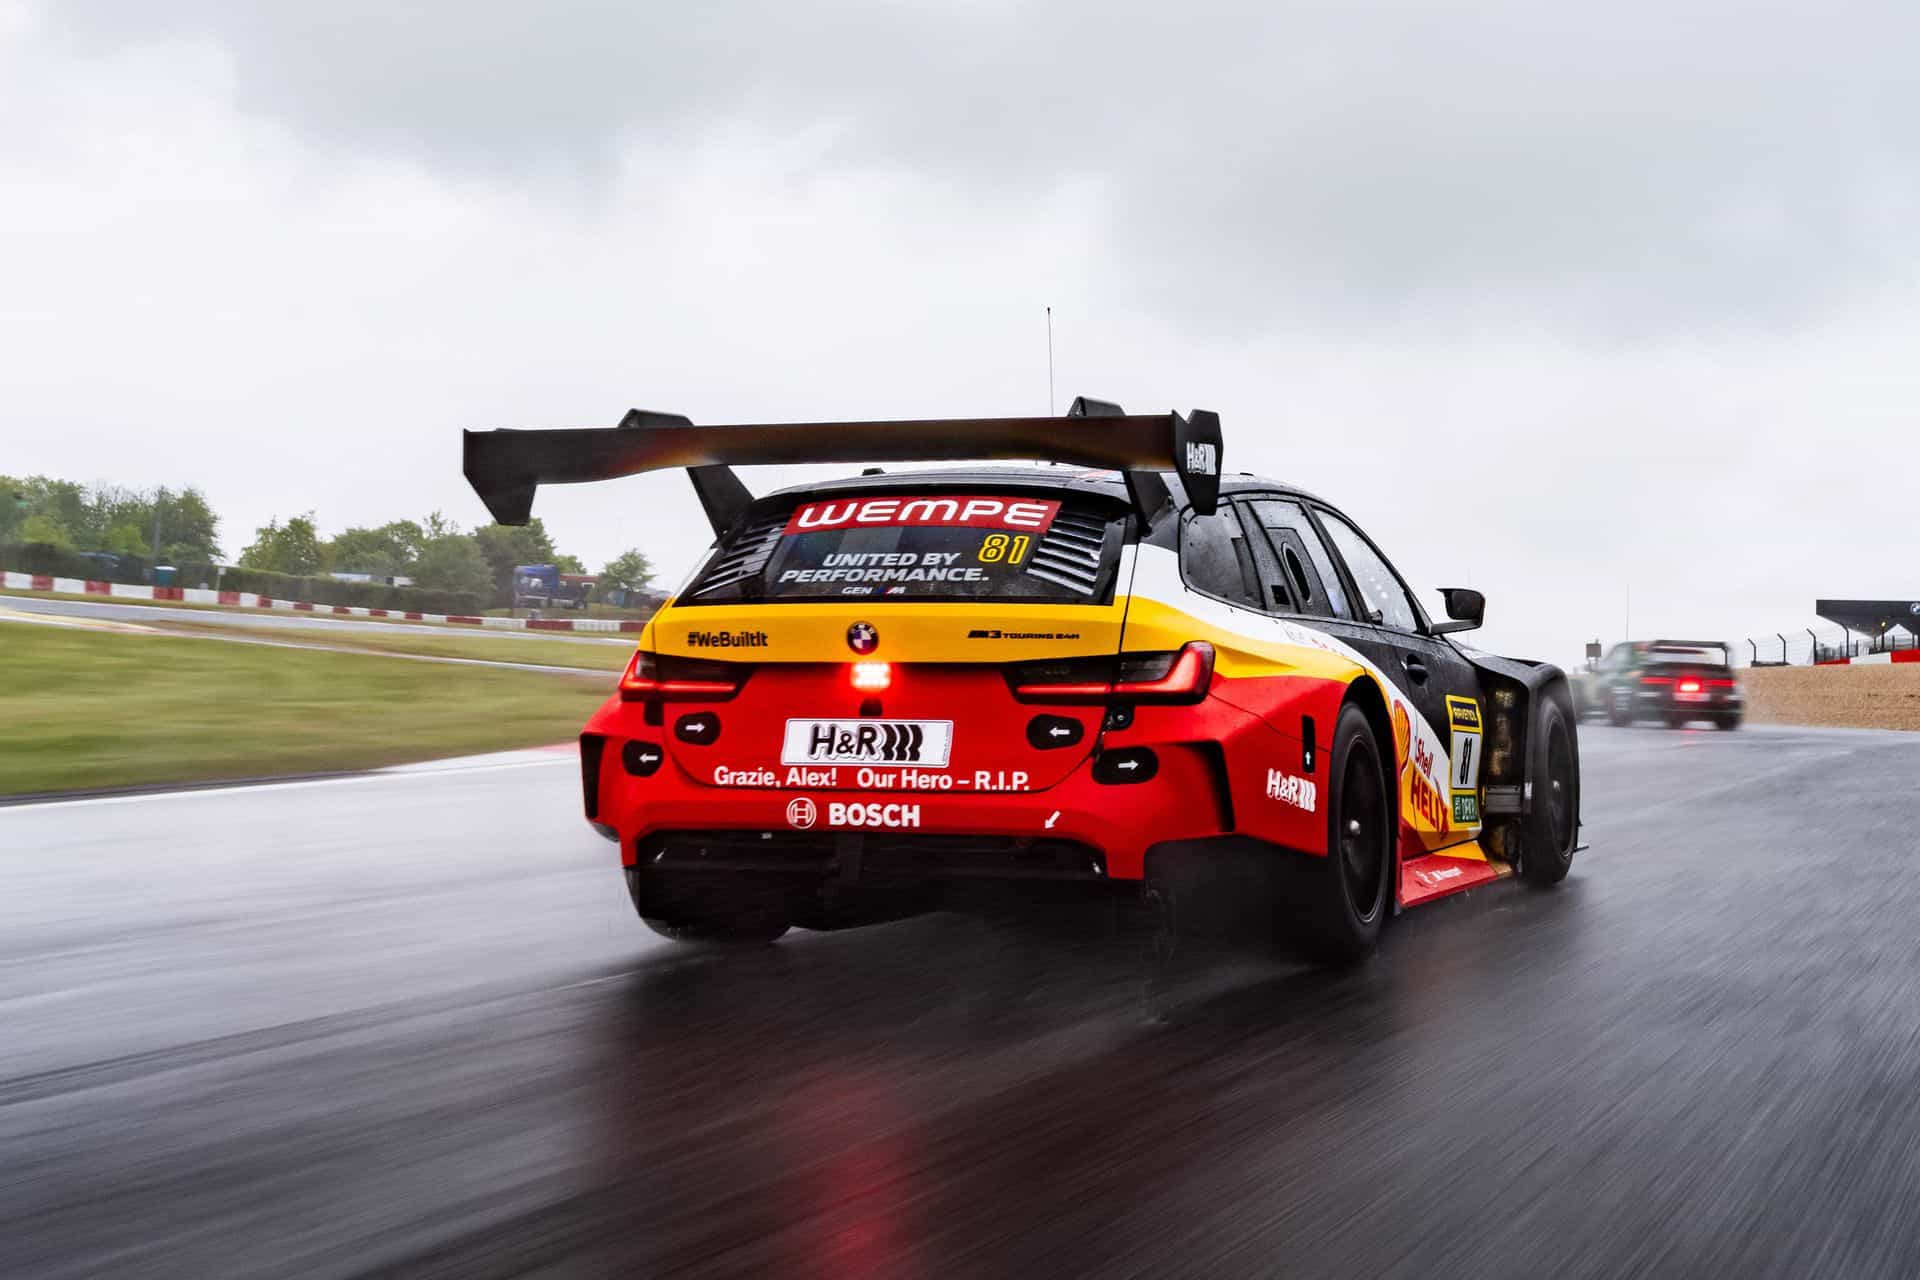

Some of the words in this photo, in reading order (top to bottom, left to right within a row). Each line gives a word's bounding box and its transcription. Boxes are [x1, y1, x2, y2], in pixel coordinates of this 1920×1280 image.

[797, 499, 1049, 528] WEMPE
[822, 552, 918, 568] UNITED
[921, 552, 961, 567] BY
[977, 533, 1030, 565] 81
[778, 567, 989, 583] PERFORMANCE.
[841, 586, 873, 595] GEN
[687, 631, 769, 647] #WeBuiltIt
[810, 724, 878, 757] H&R
[1415, 737, 1434, 778] Shell
[1459, 736, 1473, 785] 81
[713, 765, 781, 788] Grazie,
[786, 767, 837, 787] Alex!
[856, 768, 897, 788] Our
[901, 769, 953, 790] Hero
[974, 770, 1030, 792] R.I.P.
[828, 802, 921, 828] BOSCH
[1410, 765, 1450, 840] HELIX
